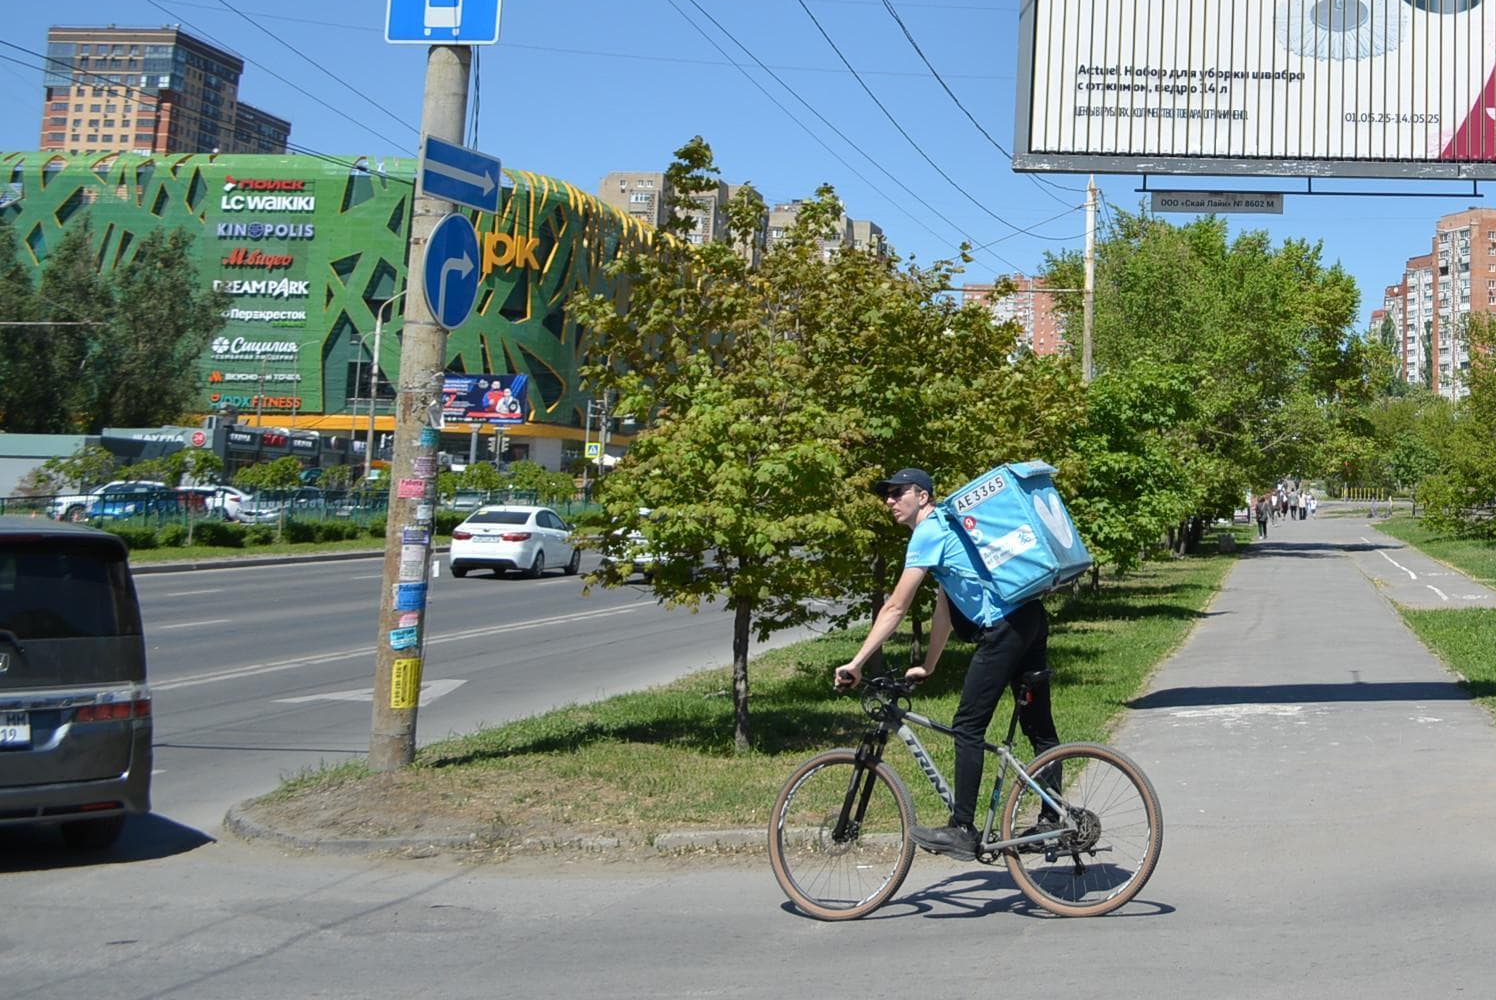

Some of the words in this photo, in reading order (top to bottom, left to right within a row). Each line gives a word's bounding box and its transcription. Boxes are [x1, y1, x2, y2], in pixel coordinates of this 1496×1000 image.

[1124, 66, 1167, 80] Набор
[1170, 69, 1197, 80] для
[1200, 68, 1249, 82] уборки
[1078, 83, 1084, 91] с
[1220, 86, 1228, 94] л
[221, 195, 245, 209] LC
[1161, 199, 1178, 207] ООО
[475, 231, 540, 274] рк
[252, 395, 302, 408] FTNESS
